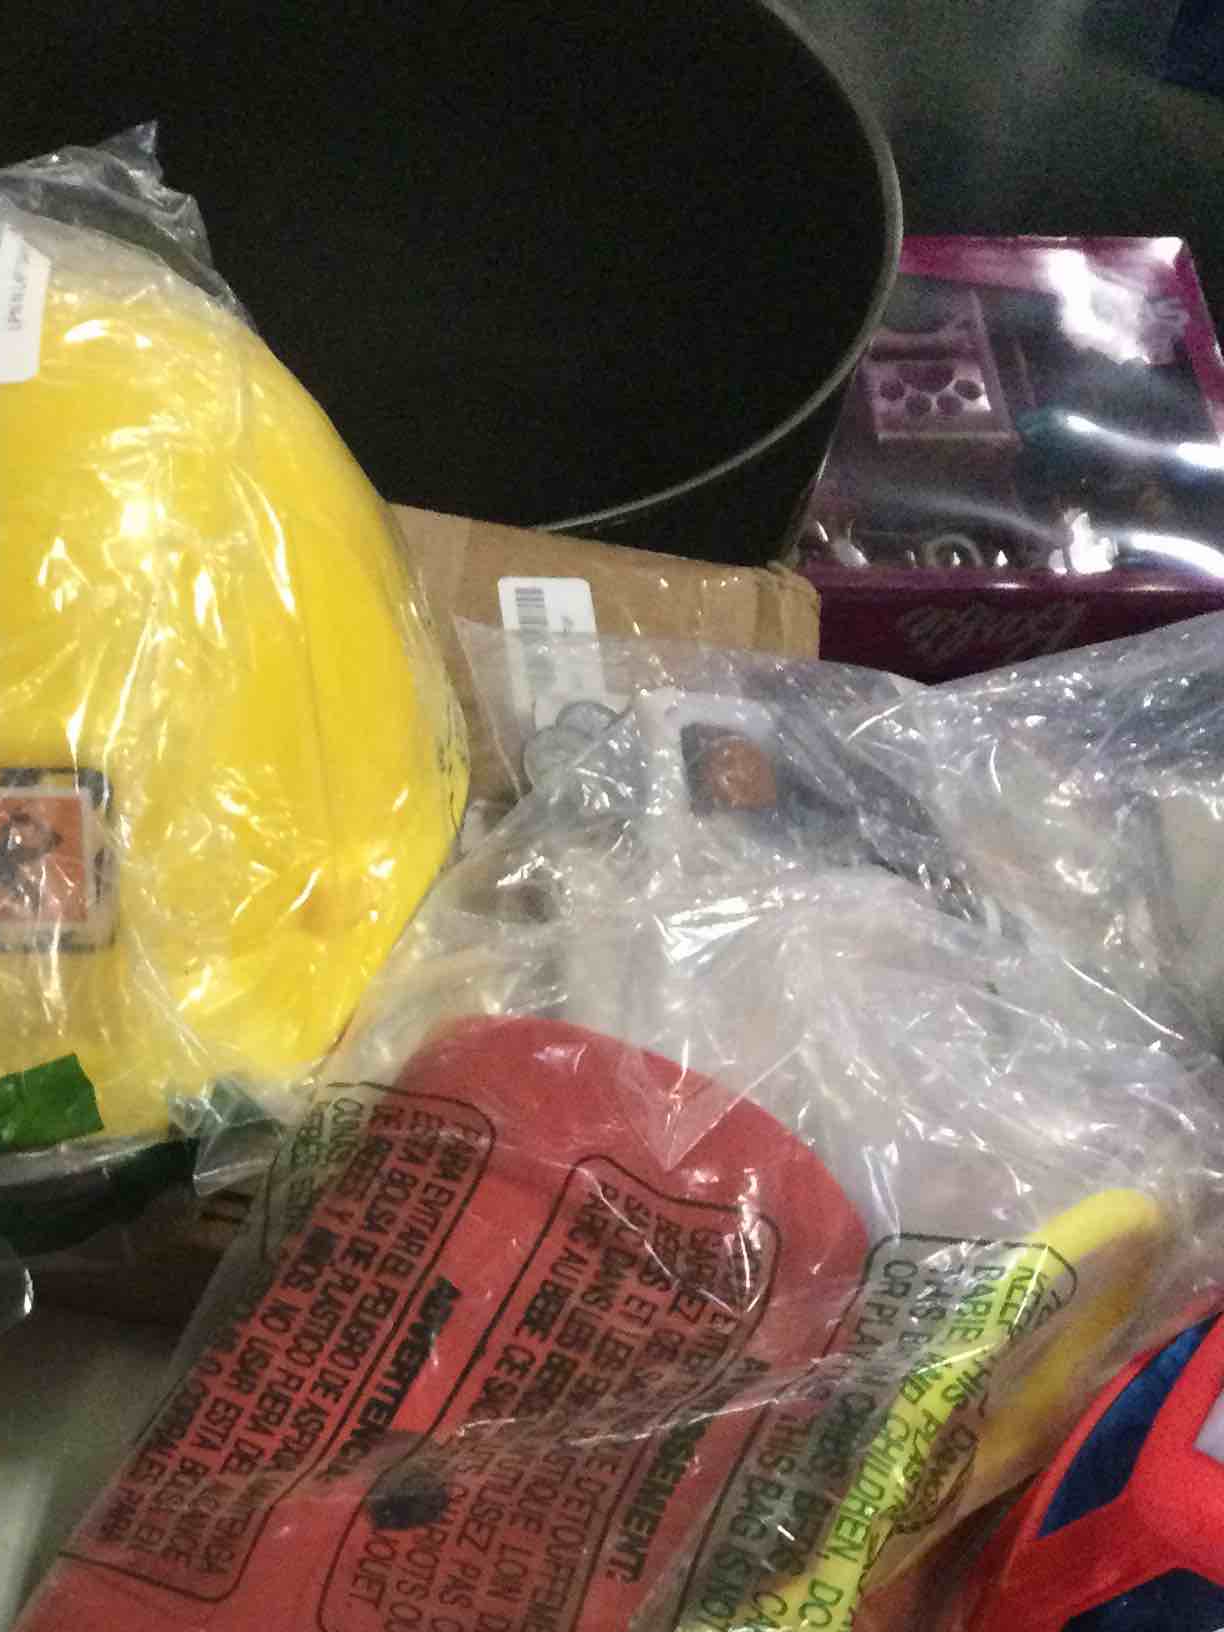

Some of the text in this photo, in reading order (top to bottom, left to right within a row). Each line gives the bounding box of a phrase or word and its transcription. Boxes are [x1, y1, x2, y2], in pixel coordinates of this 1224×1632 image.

[190, 1400, 241, 1455] ESTA
[218, 1441, 262, 1485] DEL
[818, 1417, 912, 1569] CHILDREN,
[797, 1583, 842, 1627] DO
